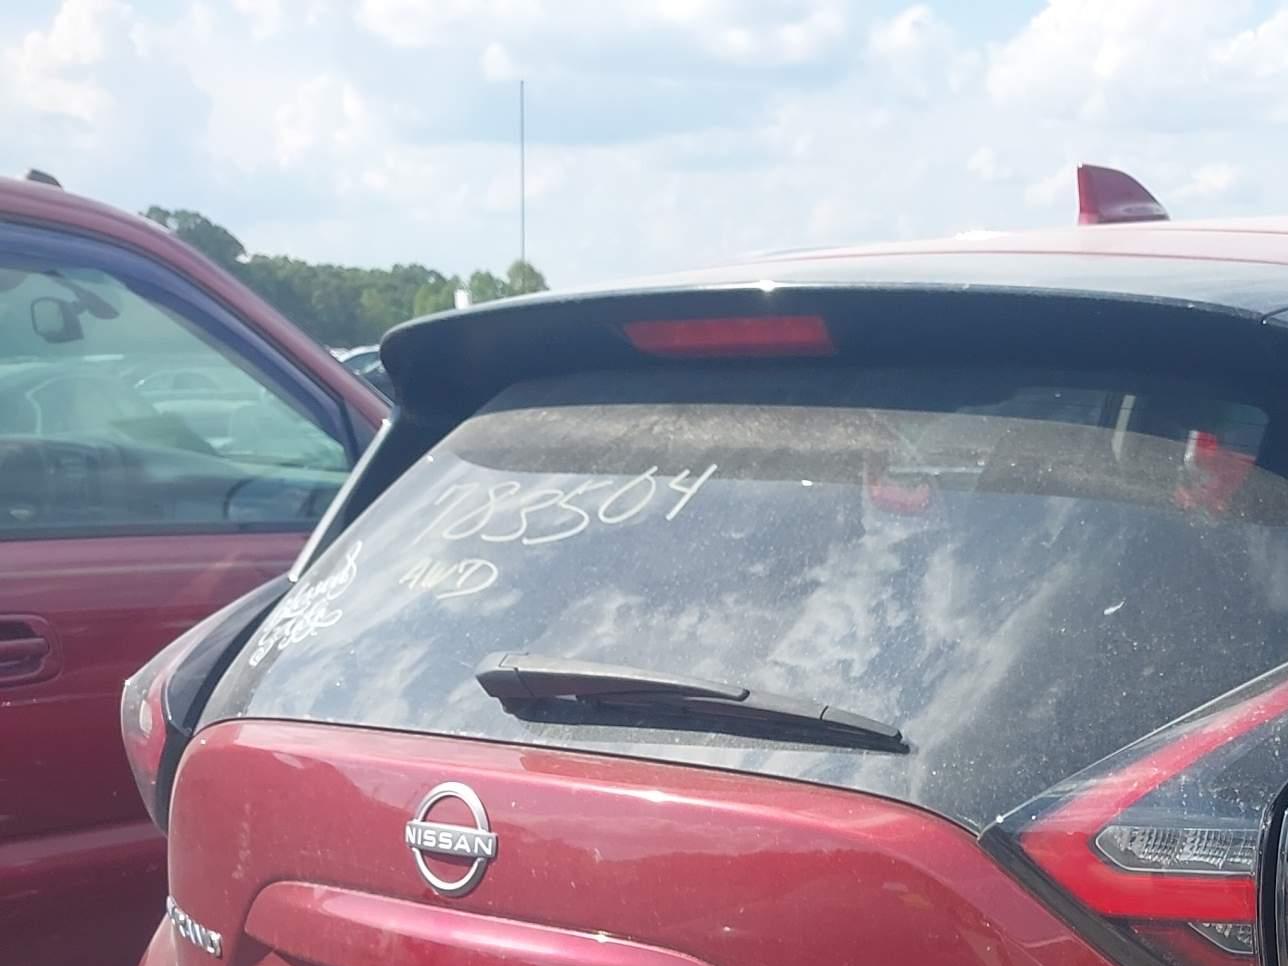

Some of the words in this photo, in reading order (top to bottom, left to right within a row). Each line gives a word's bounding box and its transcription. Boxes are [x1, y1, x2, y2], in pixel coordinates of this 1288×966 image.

[413, 464, 718, 545] 783504
[399, 559, 498, 599] AWD
[405, 825, 493, 856] NISSAN
